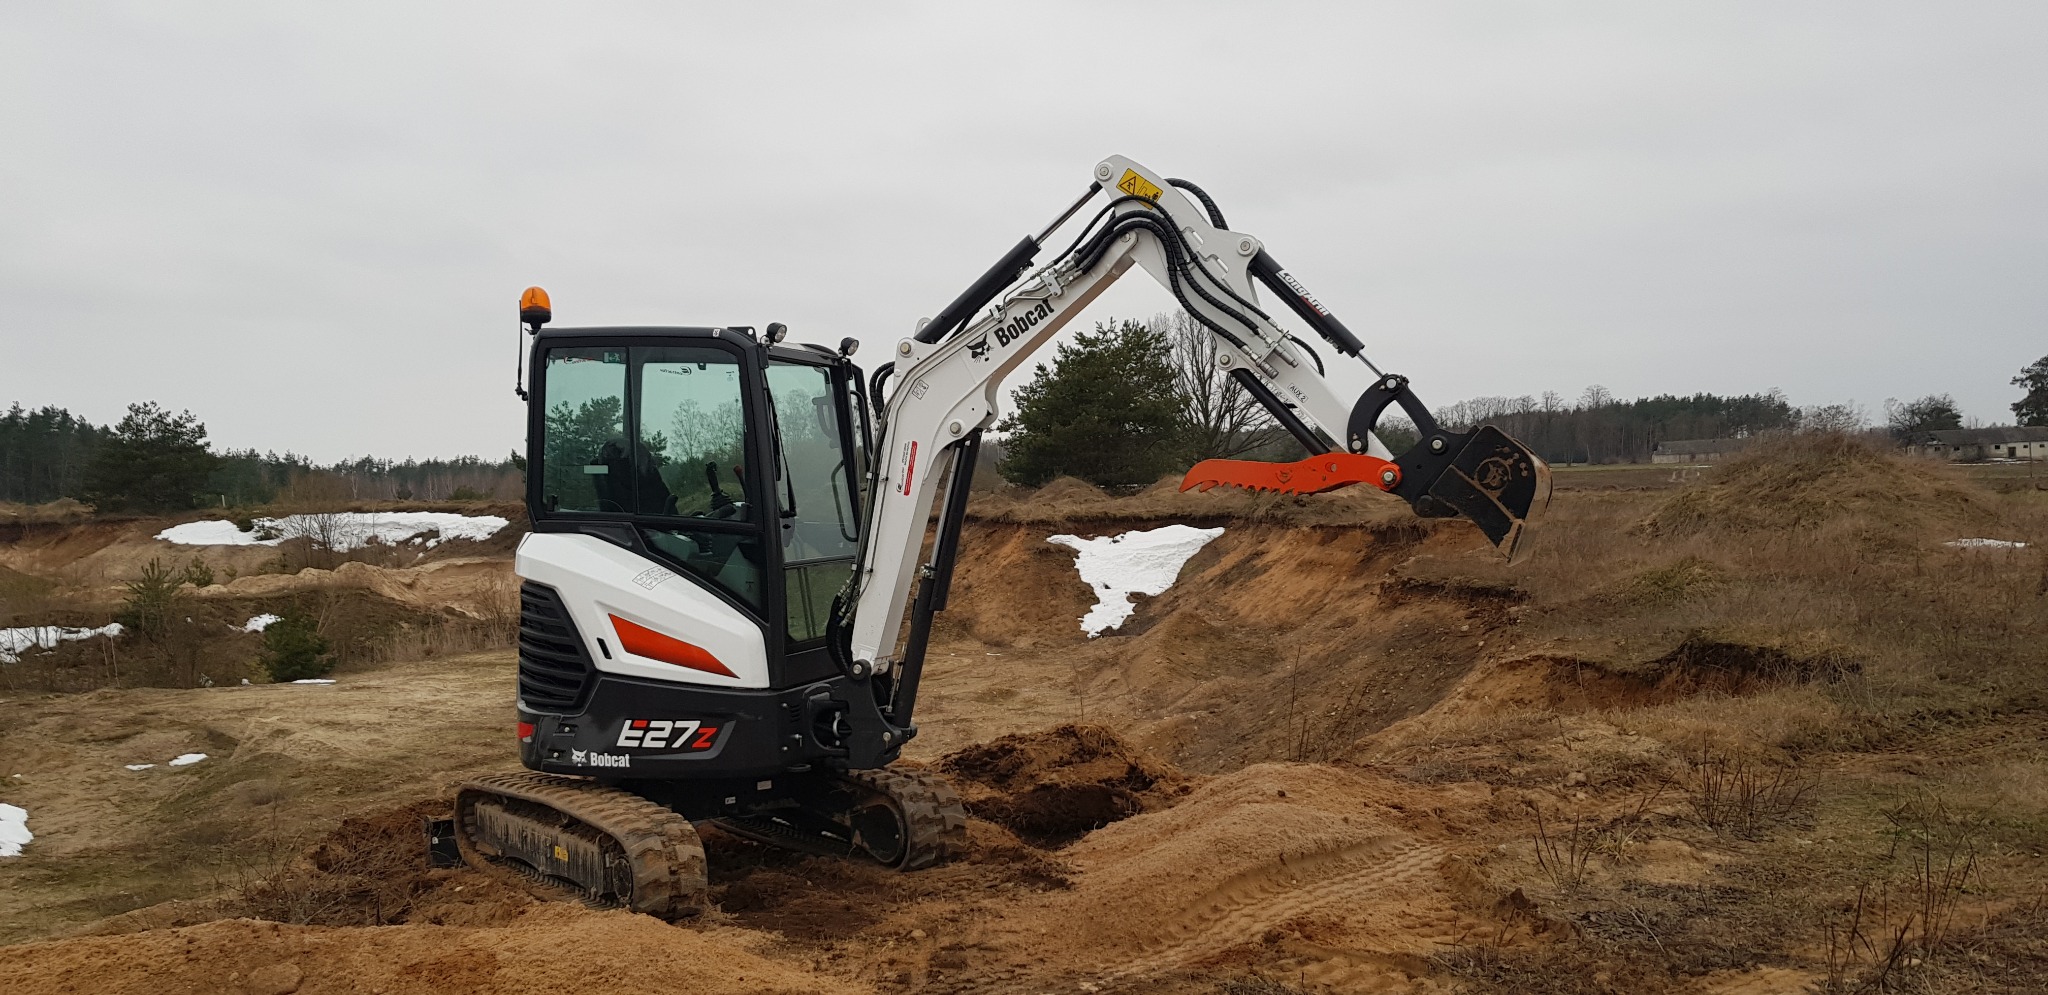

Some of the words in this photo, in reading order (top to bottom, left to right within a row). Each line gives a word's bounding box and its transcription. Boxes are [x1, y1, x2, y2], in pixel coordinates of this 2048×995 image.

[994, 299, 1054, 348] Bobcat
[1290, 386, 1302, 398] AUX
[590, 752, 630, 767] Bobcat
